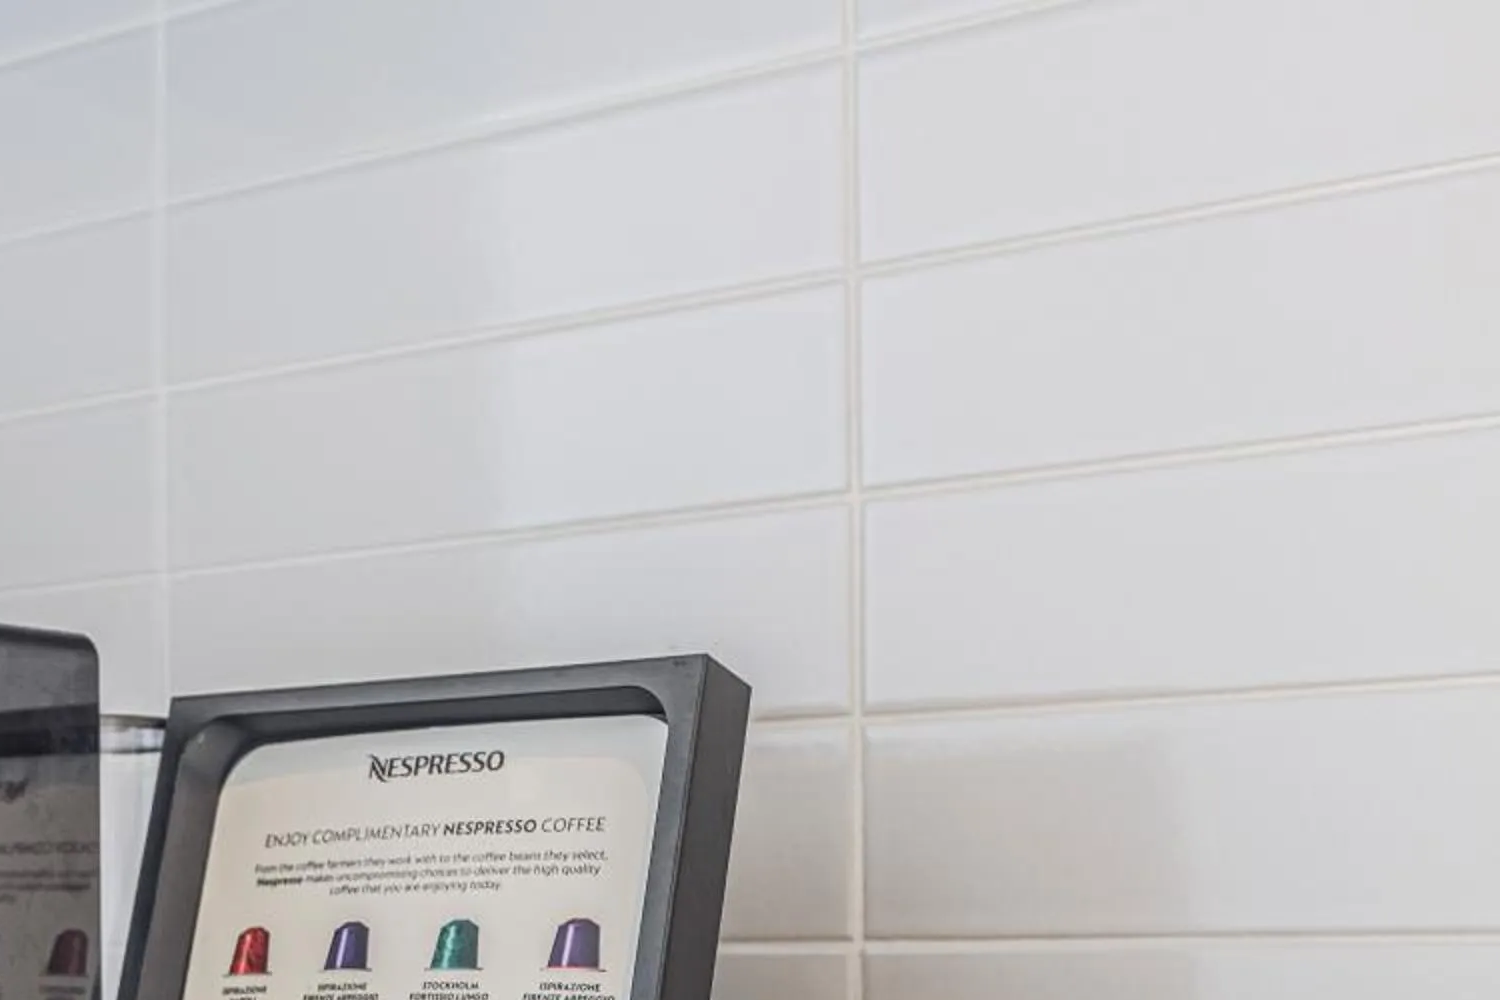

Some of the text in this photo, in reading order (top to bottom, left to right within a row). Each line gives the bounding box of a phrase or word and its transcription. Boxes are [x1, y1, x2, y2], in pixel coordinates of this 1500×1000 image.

[367, 750, 505, 782] NESPRESSO
[264, 816, 607, 849] ENJOY COMPLIMENTARY NESPRESSO COFFEE
[472, 852, 506, 862] coffee
[562, 863, 602, 877] quality
